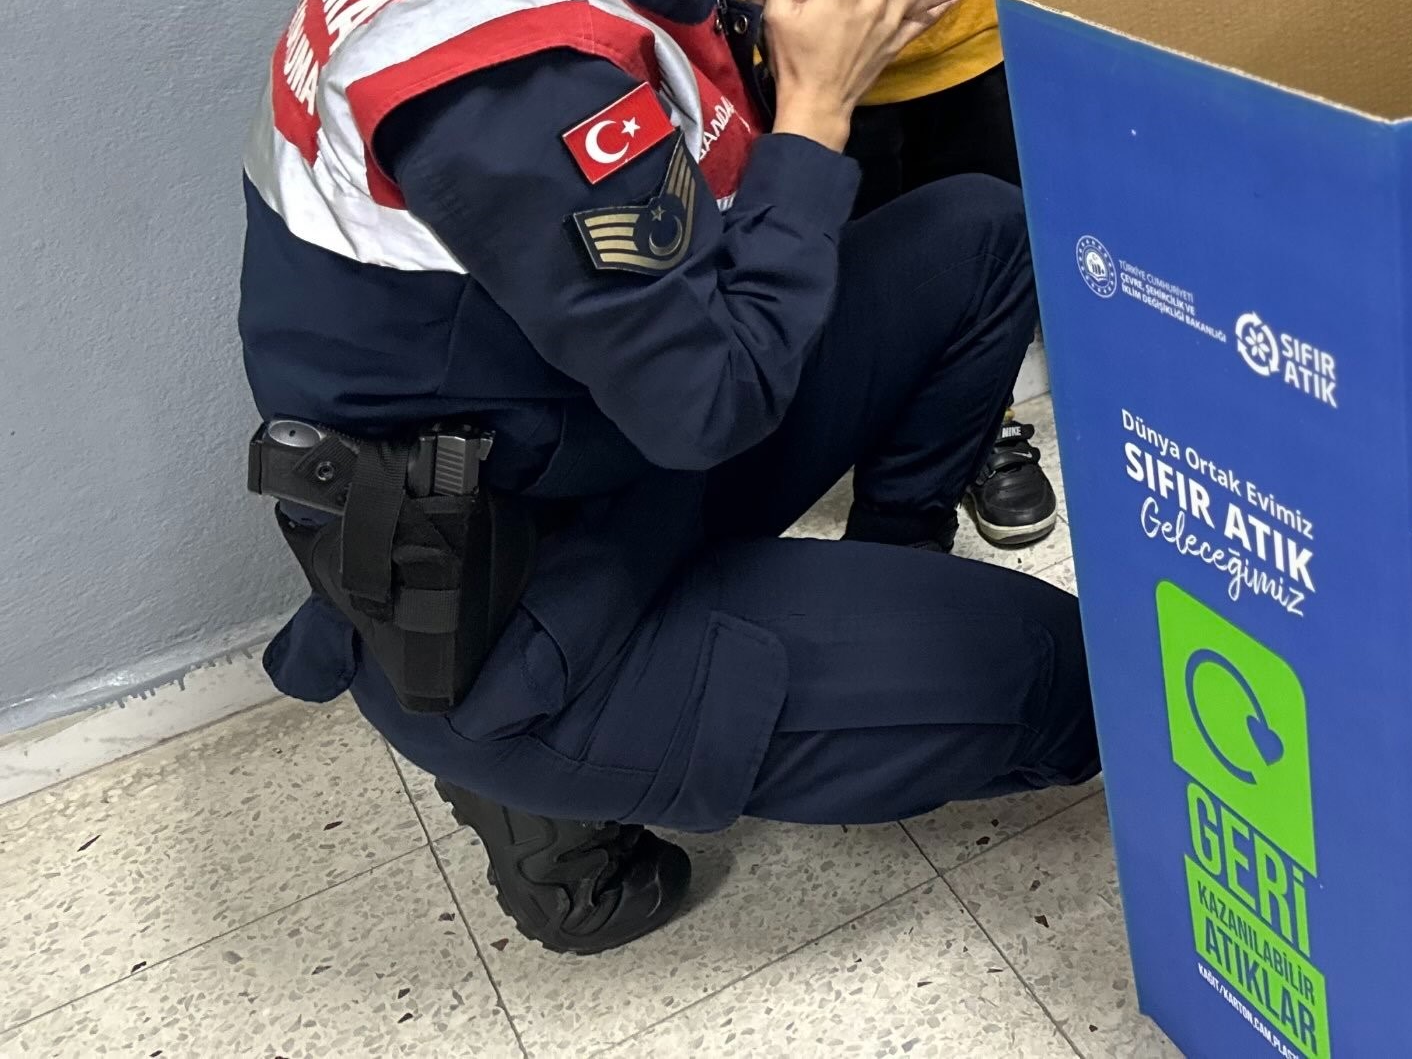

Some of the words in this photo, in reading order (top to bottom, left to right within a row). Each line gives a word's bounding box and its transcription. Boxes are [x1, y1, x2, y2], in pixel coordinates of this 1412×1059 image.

[1280, 333, 1336, 380] SIFIR
[1284, 361, 1338, 409] ATIK
[1002, 426, 1021, 438] NIKE
[1121, 408, 1181, 460] Dünya
[1185, 447, 1242, 497] Ortak
[1246, 481, 1314, 540] Evimiz
[1125, 442, 1215, 529] SIFIR
[1224, 503, 1316, 592] ATIK
[1140, 496, 1305, 617] Geleceğimiz
[1187, 781, 1311, 959] GERİ
[1197, 880, 1315, 1007] KAZANILABİLİR
[1205, 916, 1319, 1056] ATIKLAR
